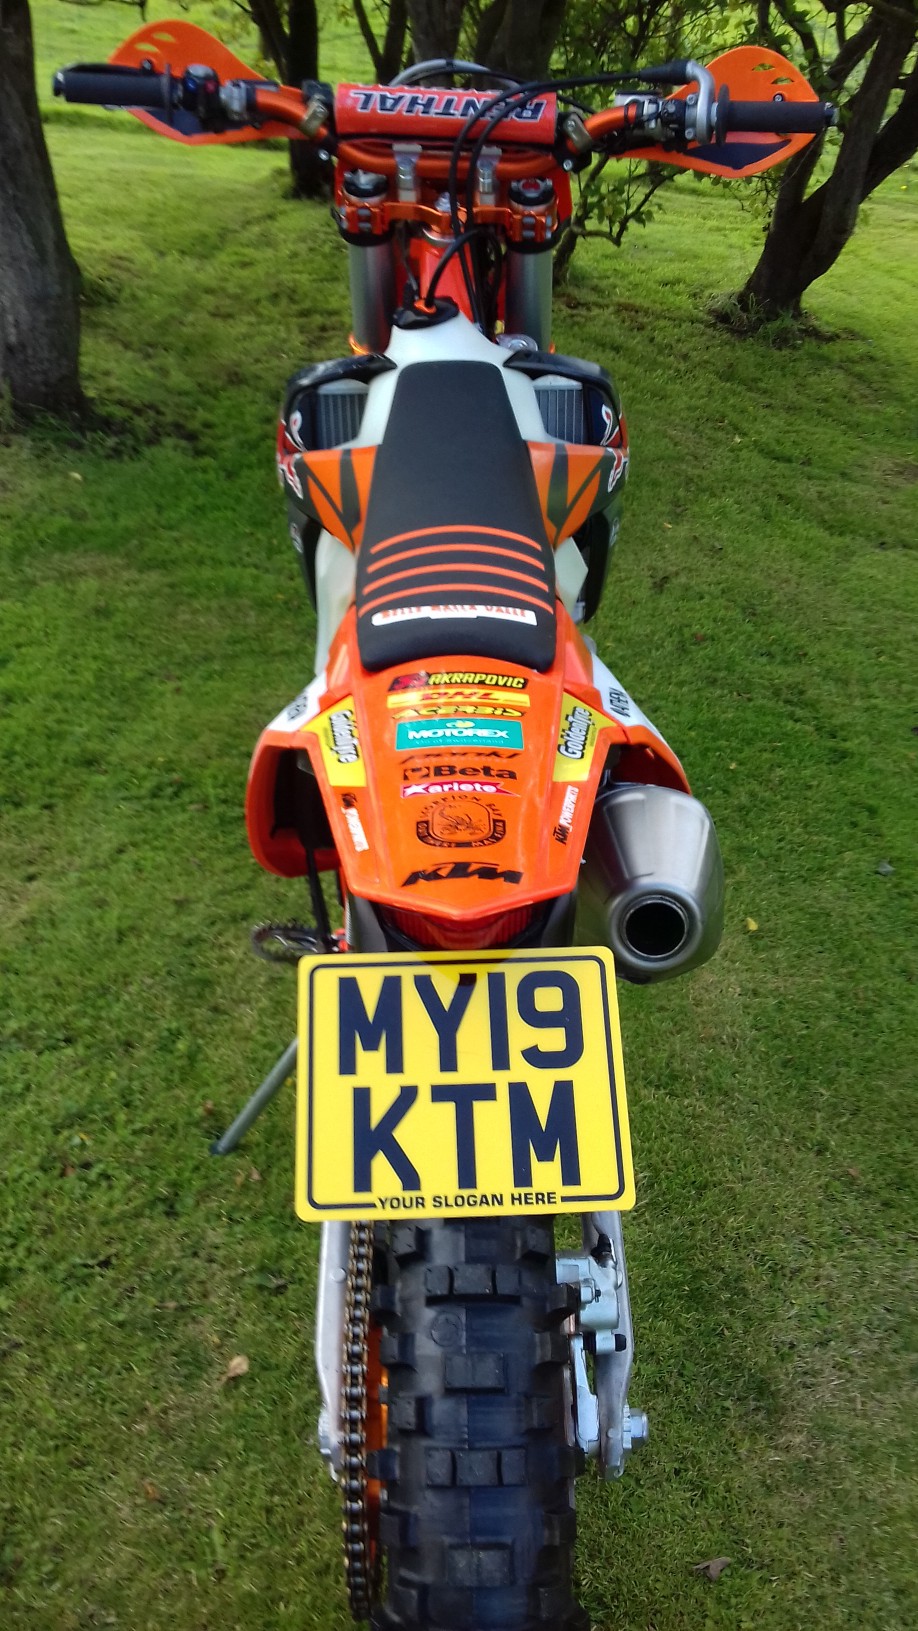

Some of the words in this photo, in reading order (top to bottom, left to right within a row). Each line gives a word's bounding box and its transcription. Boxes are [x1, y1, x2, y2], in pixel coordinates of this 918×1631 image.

[350, 90, 547, 122] RENTHAL
[428, 672, 525, 688] AKRAPOVIC
[407, 728, 509, 740] MOTOREX
[434, 765, 518, 780] Beta
[401, 862, 524, 887] KTM
[338, 970, 584, 1075] MY19
[353, 1080, 581, 1193] KTM
[378, 1197, 425, 1209] YOUR
[432, 1193, 504, 1208] SLOGAN
[511, 1191, 557, 1206] HERE
